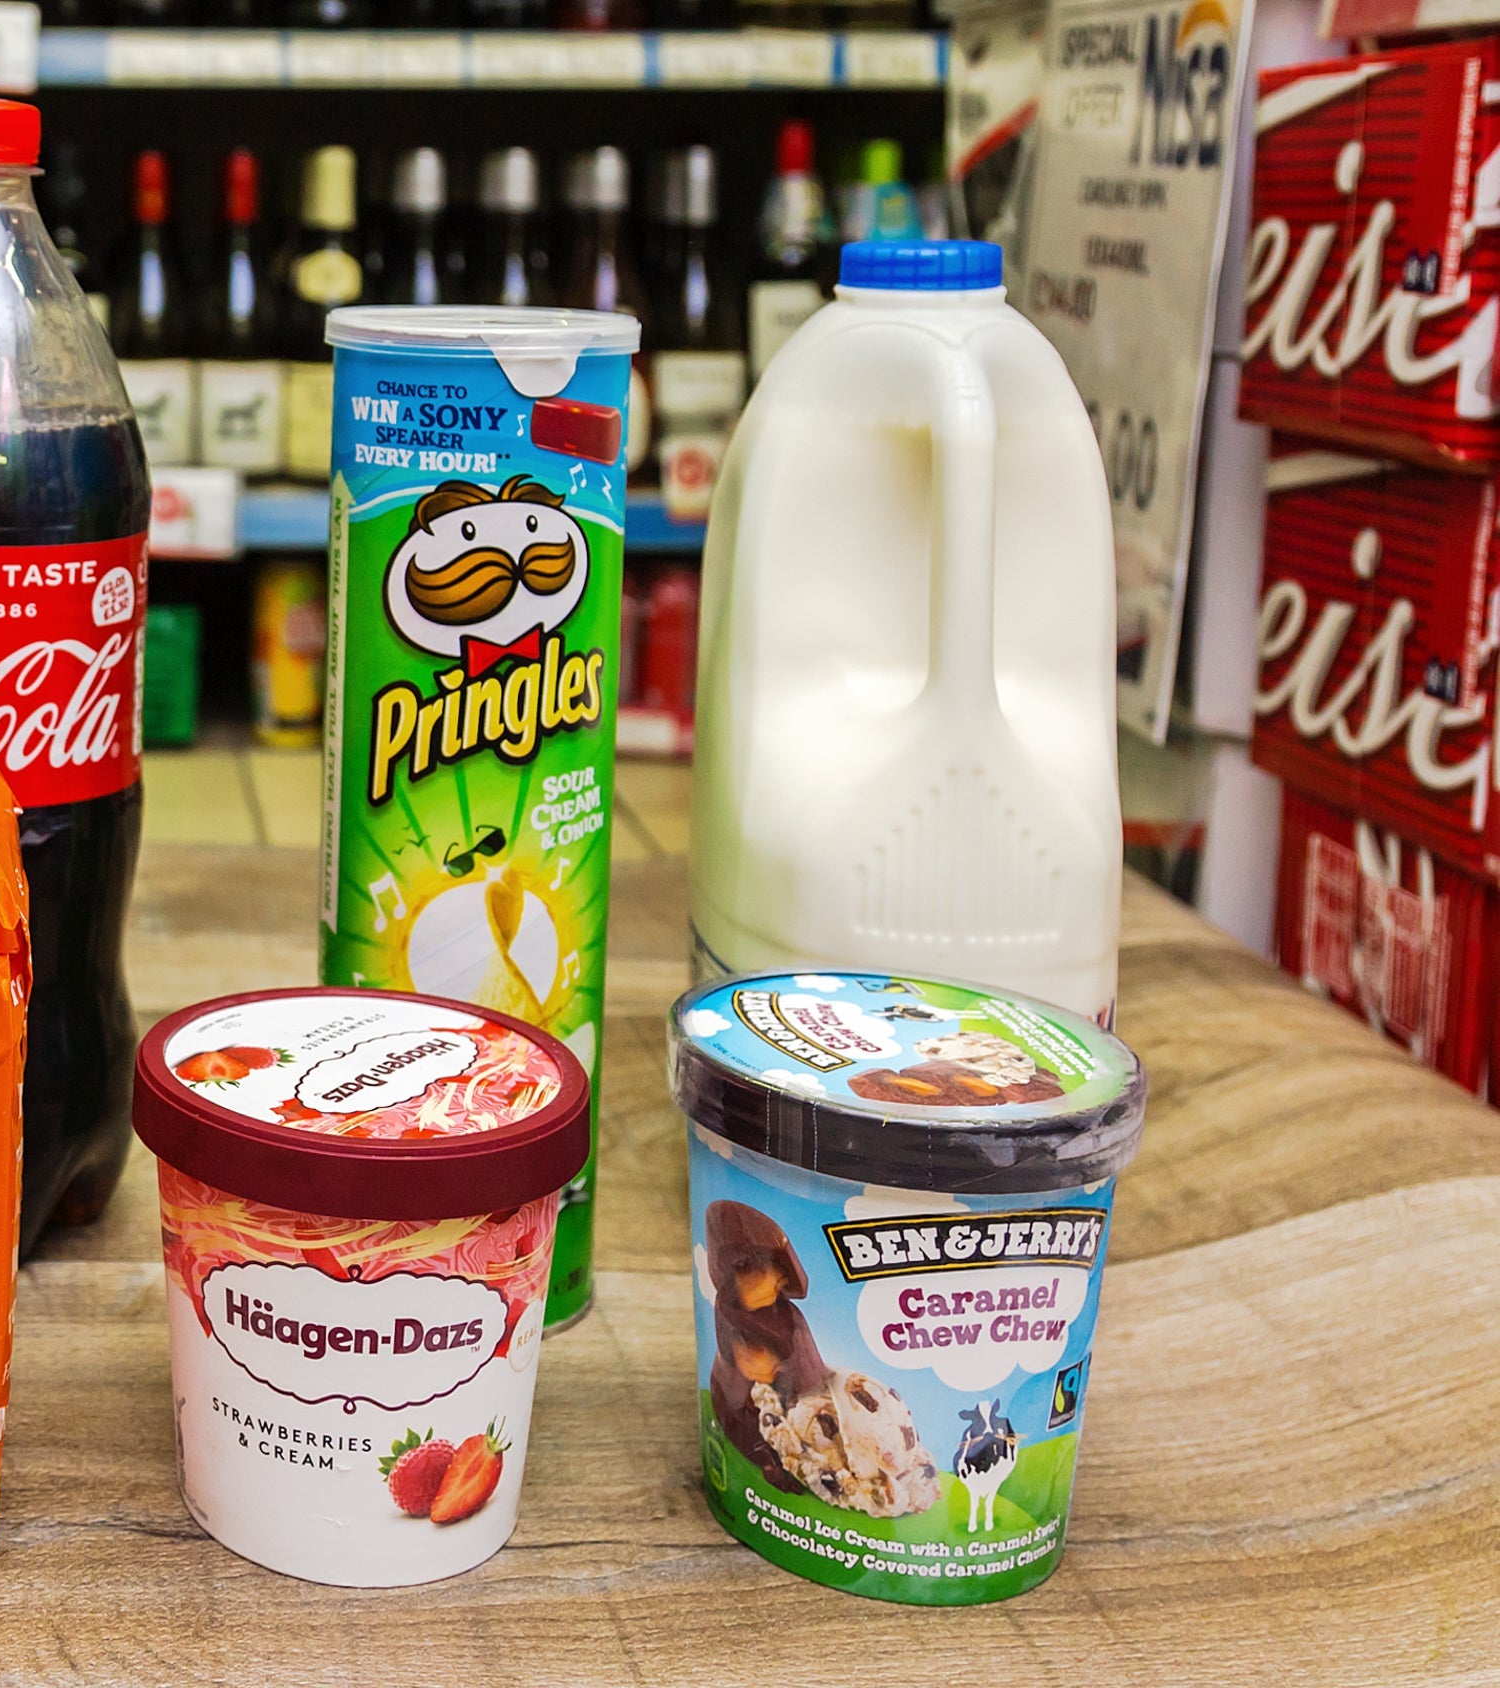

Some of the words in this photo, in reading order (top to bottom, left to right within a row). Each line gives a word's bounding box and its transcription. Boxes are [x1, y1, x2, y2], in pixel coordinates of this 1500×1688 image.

[376, 380, 438, 399] CHANCE
[442, 385, 467, 399] TO
[352, 396, 399, 424] WIN
[402, 407, 414, 422] A
[419, 403, 508, 431] SONY
[355, 444, 417, 469] EVERY
[376, 426, 463, 450] SPEAKER
[332, 497, 343, 541] CAN
[2, 560, 97, 587] TASTE
[331, 548, 342, 599] THIS
[329, 608, 340, 678] ABOUT
[328, 688, 338, 738] FULL
[369, 634, 604, 804] Pringles
[325, 745, 336, 803] HALF
[542, 766, 595, 802] SOUR
[530, 785, 601, 830] CREAM
[541, 831, 556, 850] &
[558, 812, 604, 846] ONION
[898, 1277, 1059, 1320] Caramel
[224, 1287, 483, 1360] Häagen-Dazs
[881, 1320, 982, 1352] Chew
[989, 1314, 1064, 1346] Chew
[212, 1396, 373, 1453] STRAWBERRIES
[238, 1432, 249, 1448] &
[258, 1440, 335, 1471] CREAM
[745, 1487, 812, 1532] Caramel
[814, 1518, 842, 1541] Ice
[844, 1529, 906, 1555] Cream
[909, 1541, 950, 1558] with
[953, 1545, 965, 1557] a
[968, 1531, 1032, 1557] Caramel
[1033, 1513, 1062, 1542] Swirl
[746, 1508, 759, 1525] &
[760, 1517, 860, 1569] Chocolatey
[862, 1553, 942, 1578] Covered
[944, 1555, 1015, 1578] Caramel
[1016, 1538, 1058, 1567] Chunks
